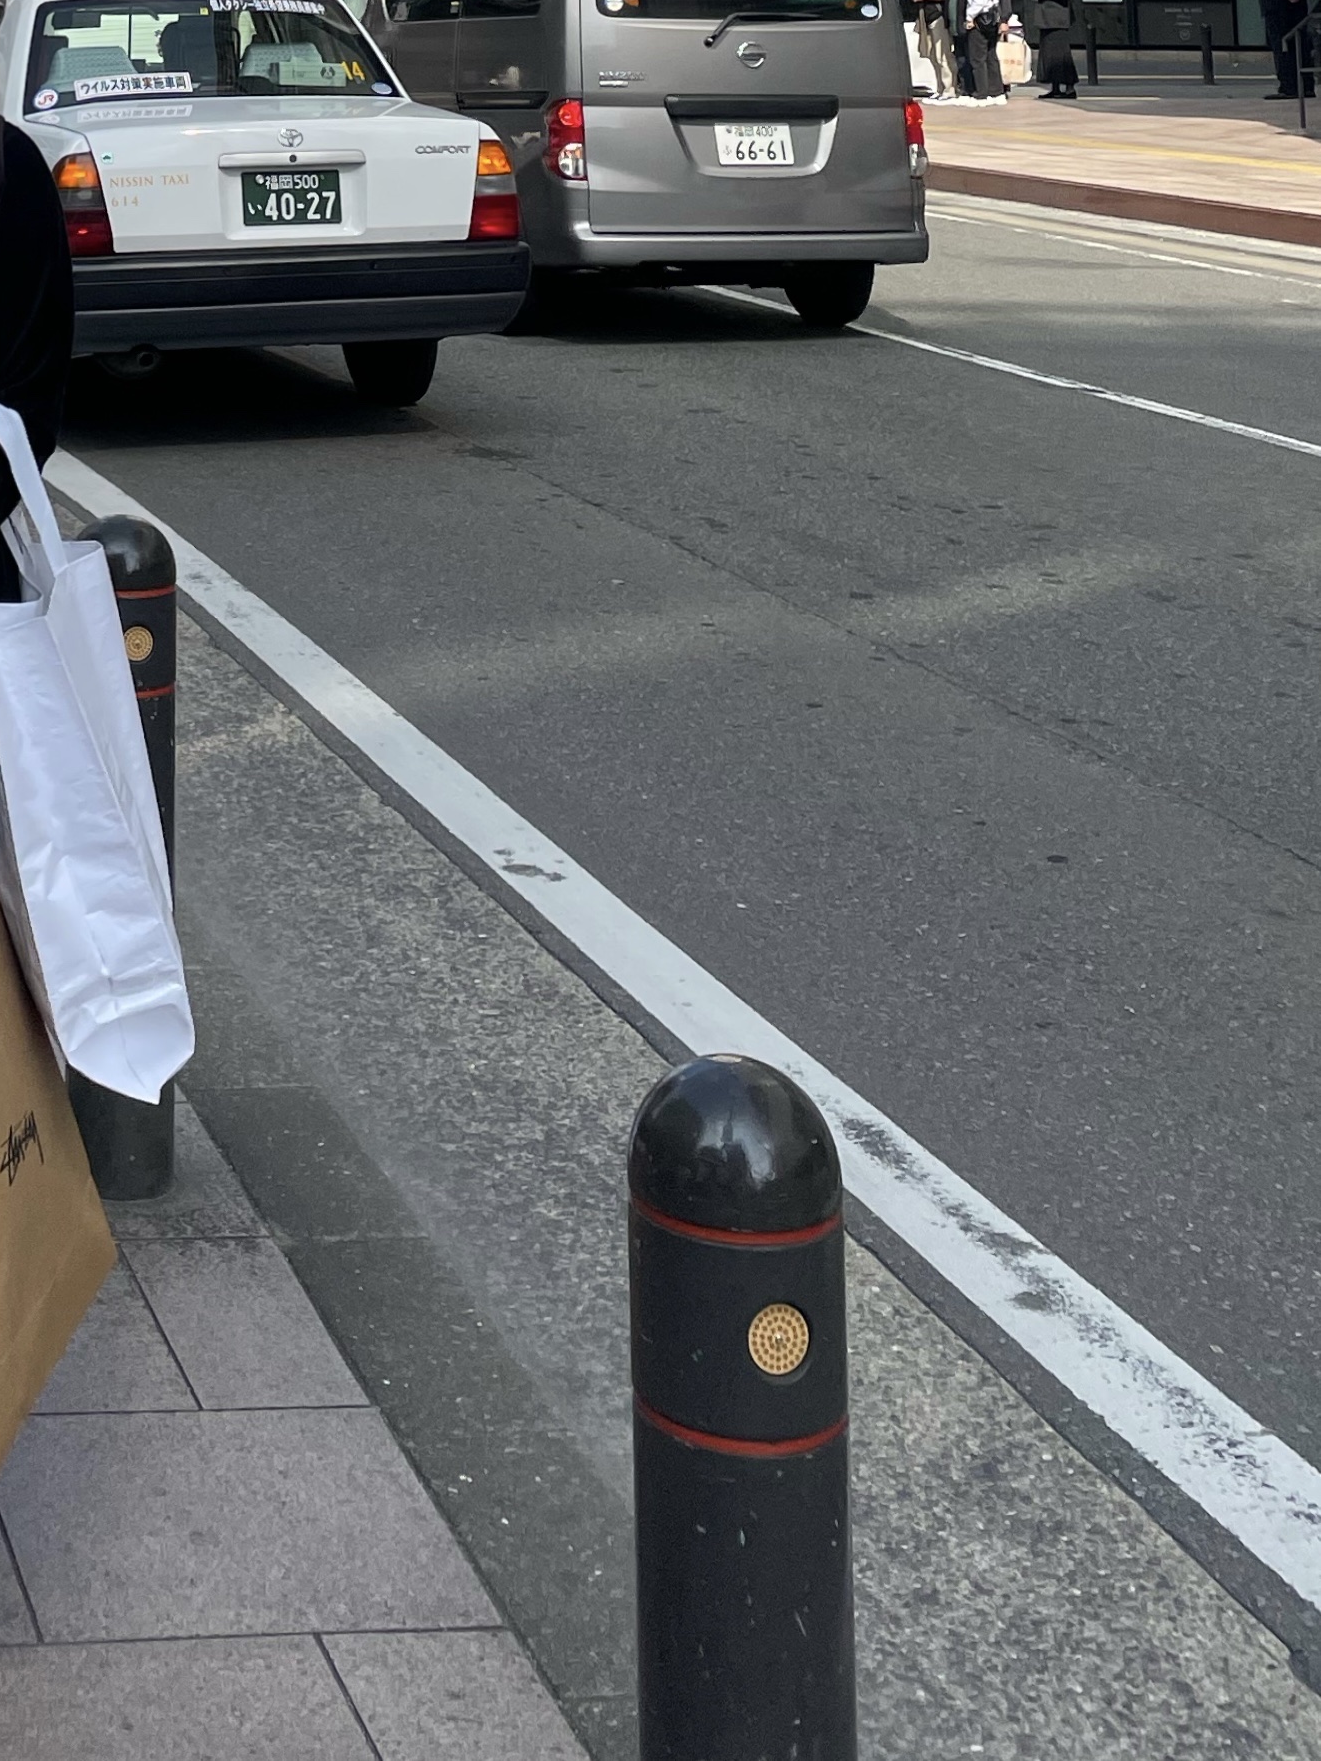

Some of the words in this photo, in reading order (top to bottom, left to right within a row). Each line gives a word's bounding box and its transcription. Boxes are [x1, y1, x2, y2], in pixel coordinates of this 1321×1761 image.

[341, 61, 365, 81] 14
[80, 76, 186, 95] ウイルス対策実施車両
[415, 145, 471, 155] COMFORT
[736, 140, 787, 161] 66-61
[109, 176, 154, 188] NISSIN
[161, 173, 190, 185] TAXI
[293, 175, 319, 189] 500
[111, 196, 139, 207] 614
[248, 202, 263, 215] い
[265, 191, 336, 221] 40-27
